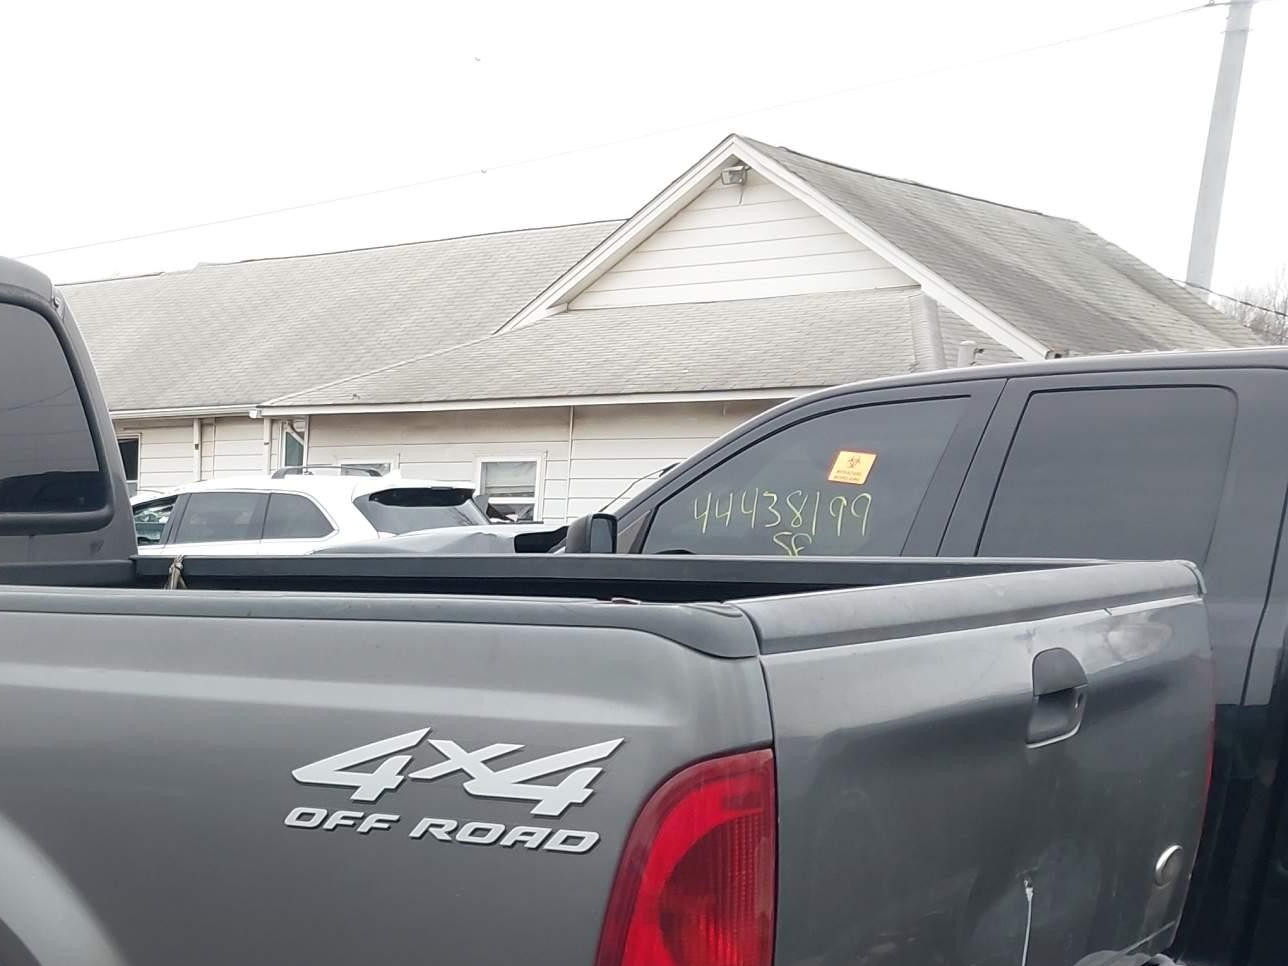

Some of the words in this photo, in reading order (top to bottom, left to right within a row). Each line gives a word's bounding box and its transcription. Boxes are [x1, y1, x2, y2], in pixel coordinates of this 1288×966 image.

[693, 487, 872, 537] 44438199
[284, 806, 401, 833] OFF
[409, 817, 601, 853] ROAD
